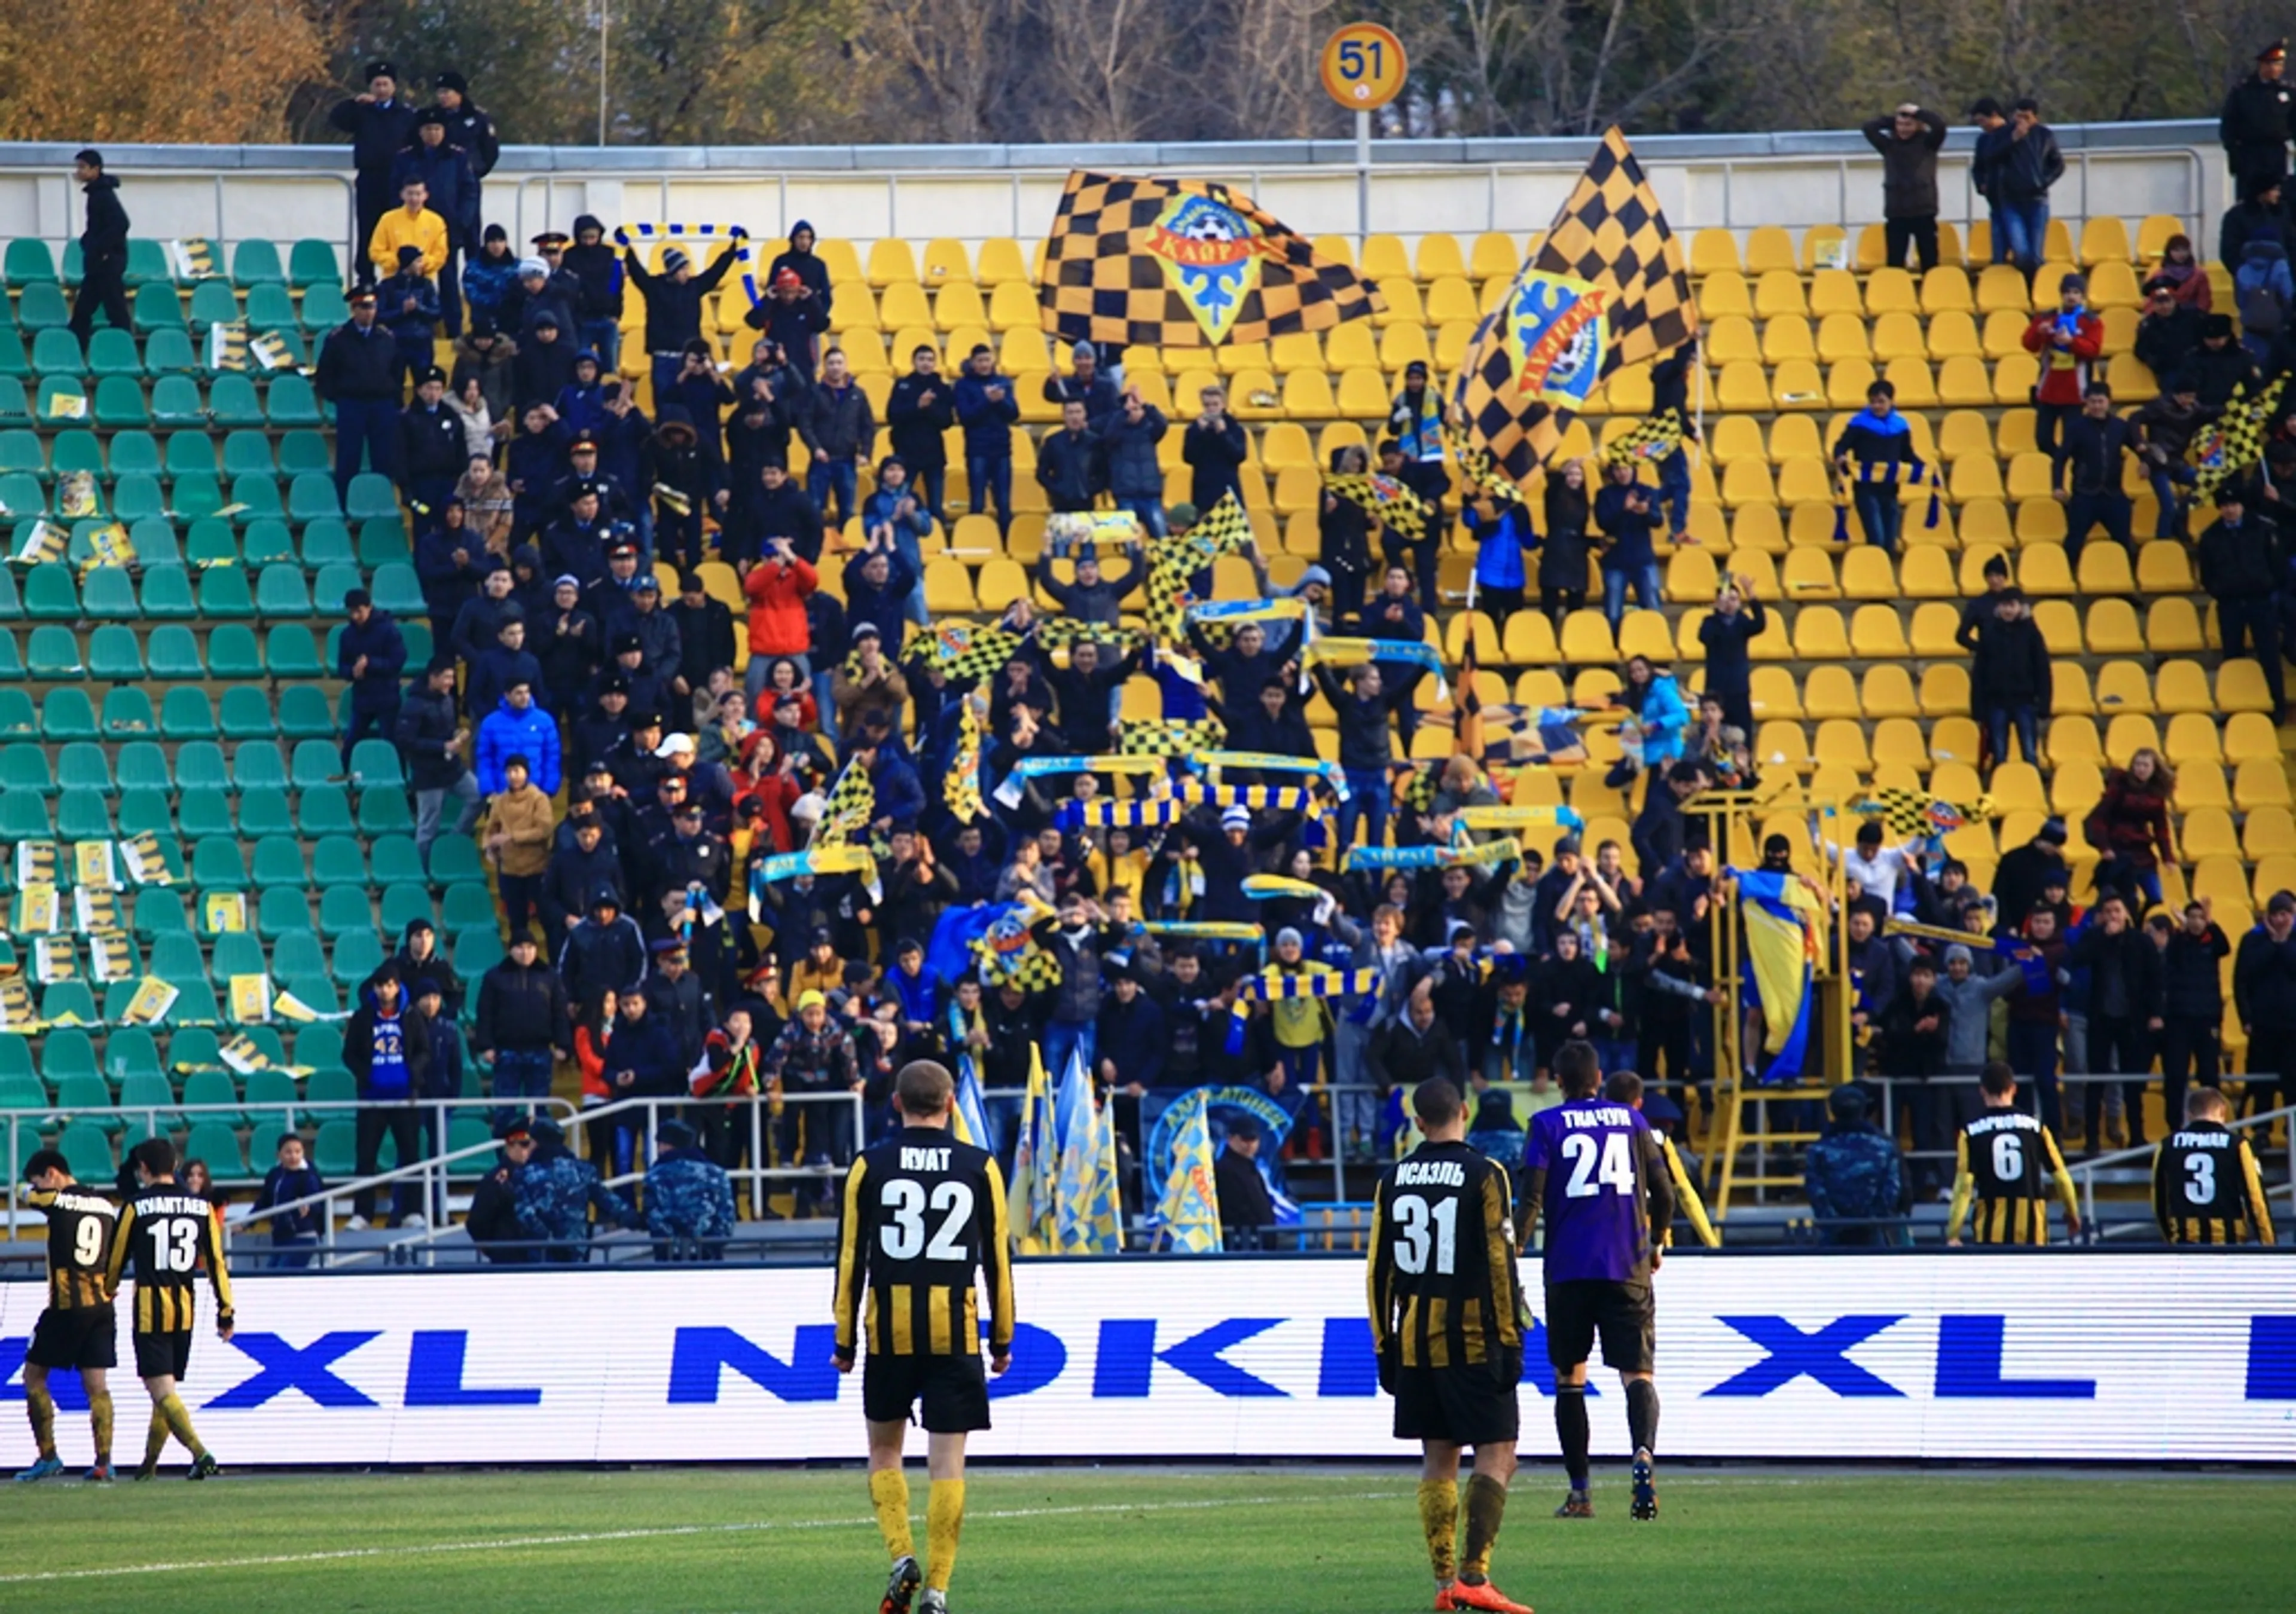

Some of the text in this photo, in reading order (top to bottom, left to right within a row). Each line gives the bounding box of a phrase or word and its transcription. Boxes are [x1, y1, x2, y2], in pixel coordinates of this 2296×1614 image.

[1339, 40, 1381, 80] 51
[1561, 1107, 1632, 1129] ТКАЧУК
[900, 1147, 952, 1170] КУАТ
[1562, 1132, 1636, 1198] 24
[1992, 1133, 2023, 1182] 6
[2184, 1151, 2216, 1205] 3
[74, 1215, 102, 1266] 9
[147, 1216, 199, 1272] 13
[880, 1178, 974, 1261] 32
[1392, 1194, 1458, 1274] 31
[197, 1329, 542, 1408] XL
[1698, 1313, 2097, 1401] XL
